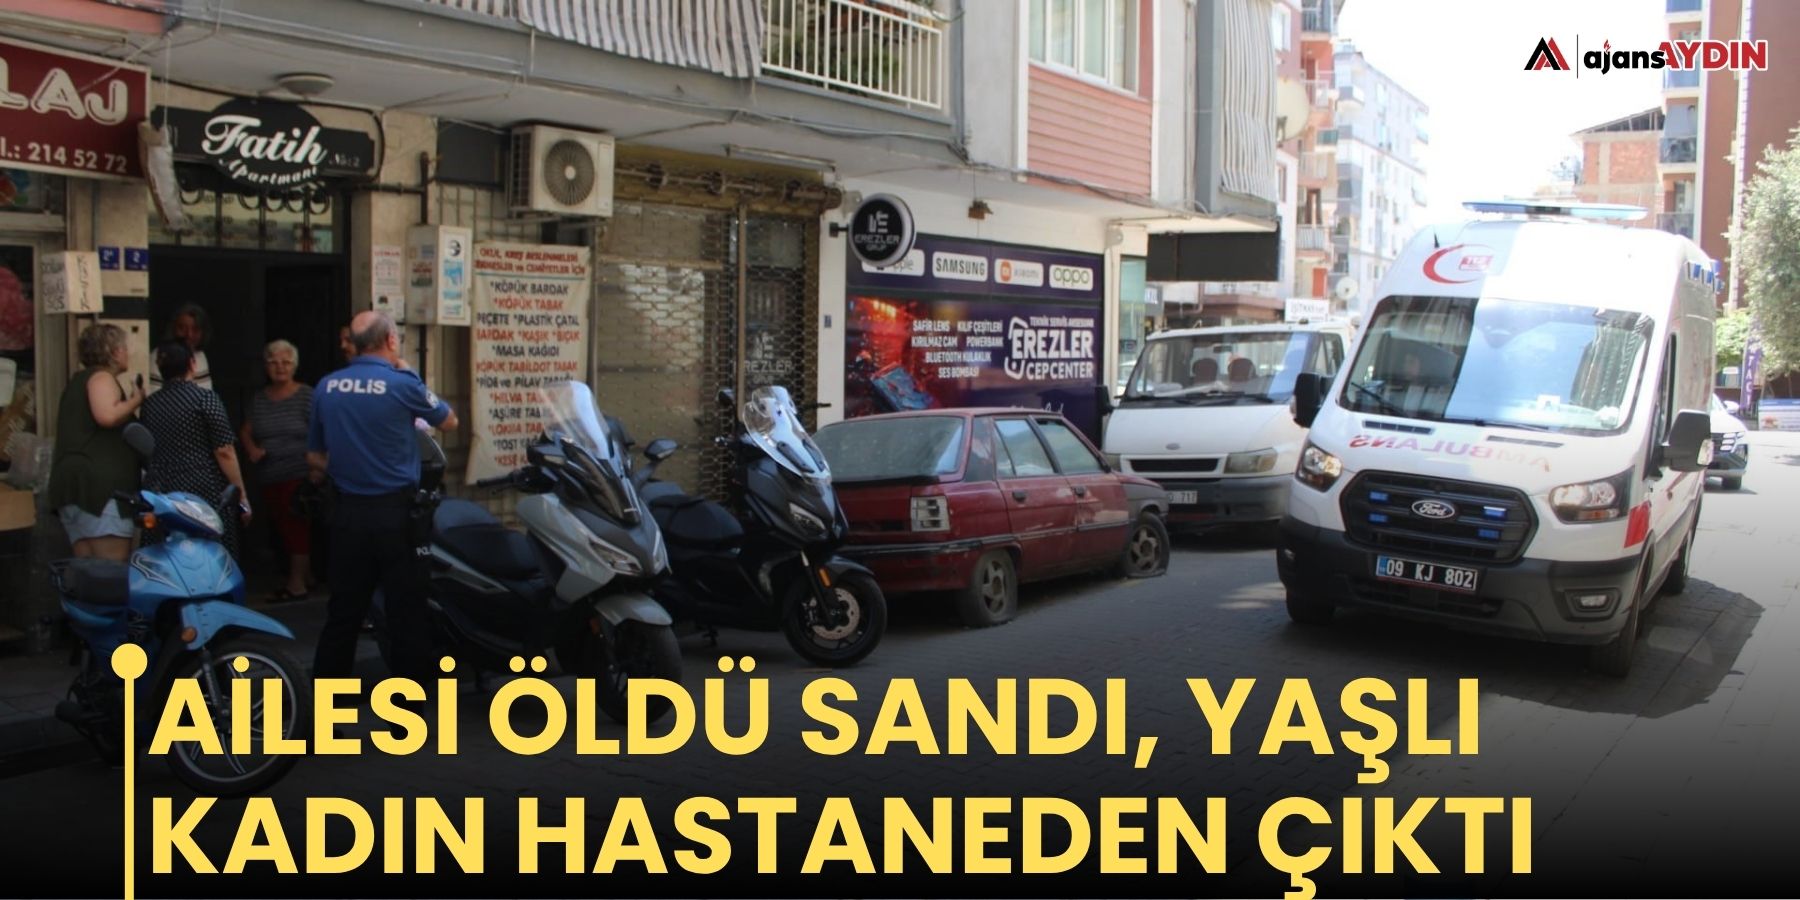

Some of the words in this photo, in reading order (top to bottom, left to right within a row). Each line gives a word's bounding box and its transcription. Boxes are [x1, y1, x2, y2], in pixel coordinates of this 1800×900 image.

[201, 114, 327, 166] Fatih
[27, 141, 67, 165] 214
[73, 148, 98, 169] 52
[104, 153, 128, 173] 72
[854, 234, 900, 244] EREZLER
[935, 257, 985, 276] SAMSUNG
[1053, 267, 1090, 287] oppo
[531, 283, 569, 295] BARDAK
[536, 299, 563, 310] TABAK
[555, 315, 580, 328] ÇATAL
[943, 336, 958, 348] CAM
[966, 336, 1004, 348] POWERBANK
[1012, 328, 1094, 359] EREZLER
[528, 344, 560, 357] KAĞIDI
[925, 351, 961, 363] BLUETOOTH
[743, 360, 793, 373] REZLER
[938, 366, 951, 378] SES
[1419, 502, 1448, 517] Ford
[1386, 559, 1404, 576] 09
[1415, 563, 1434, 581] KJ
[1444, 568, 1473, 588] 802
